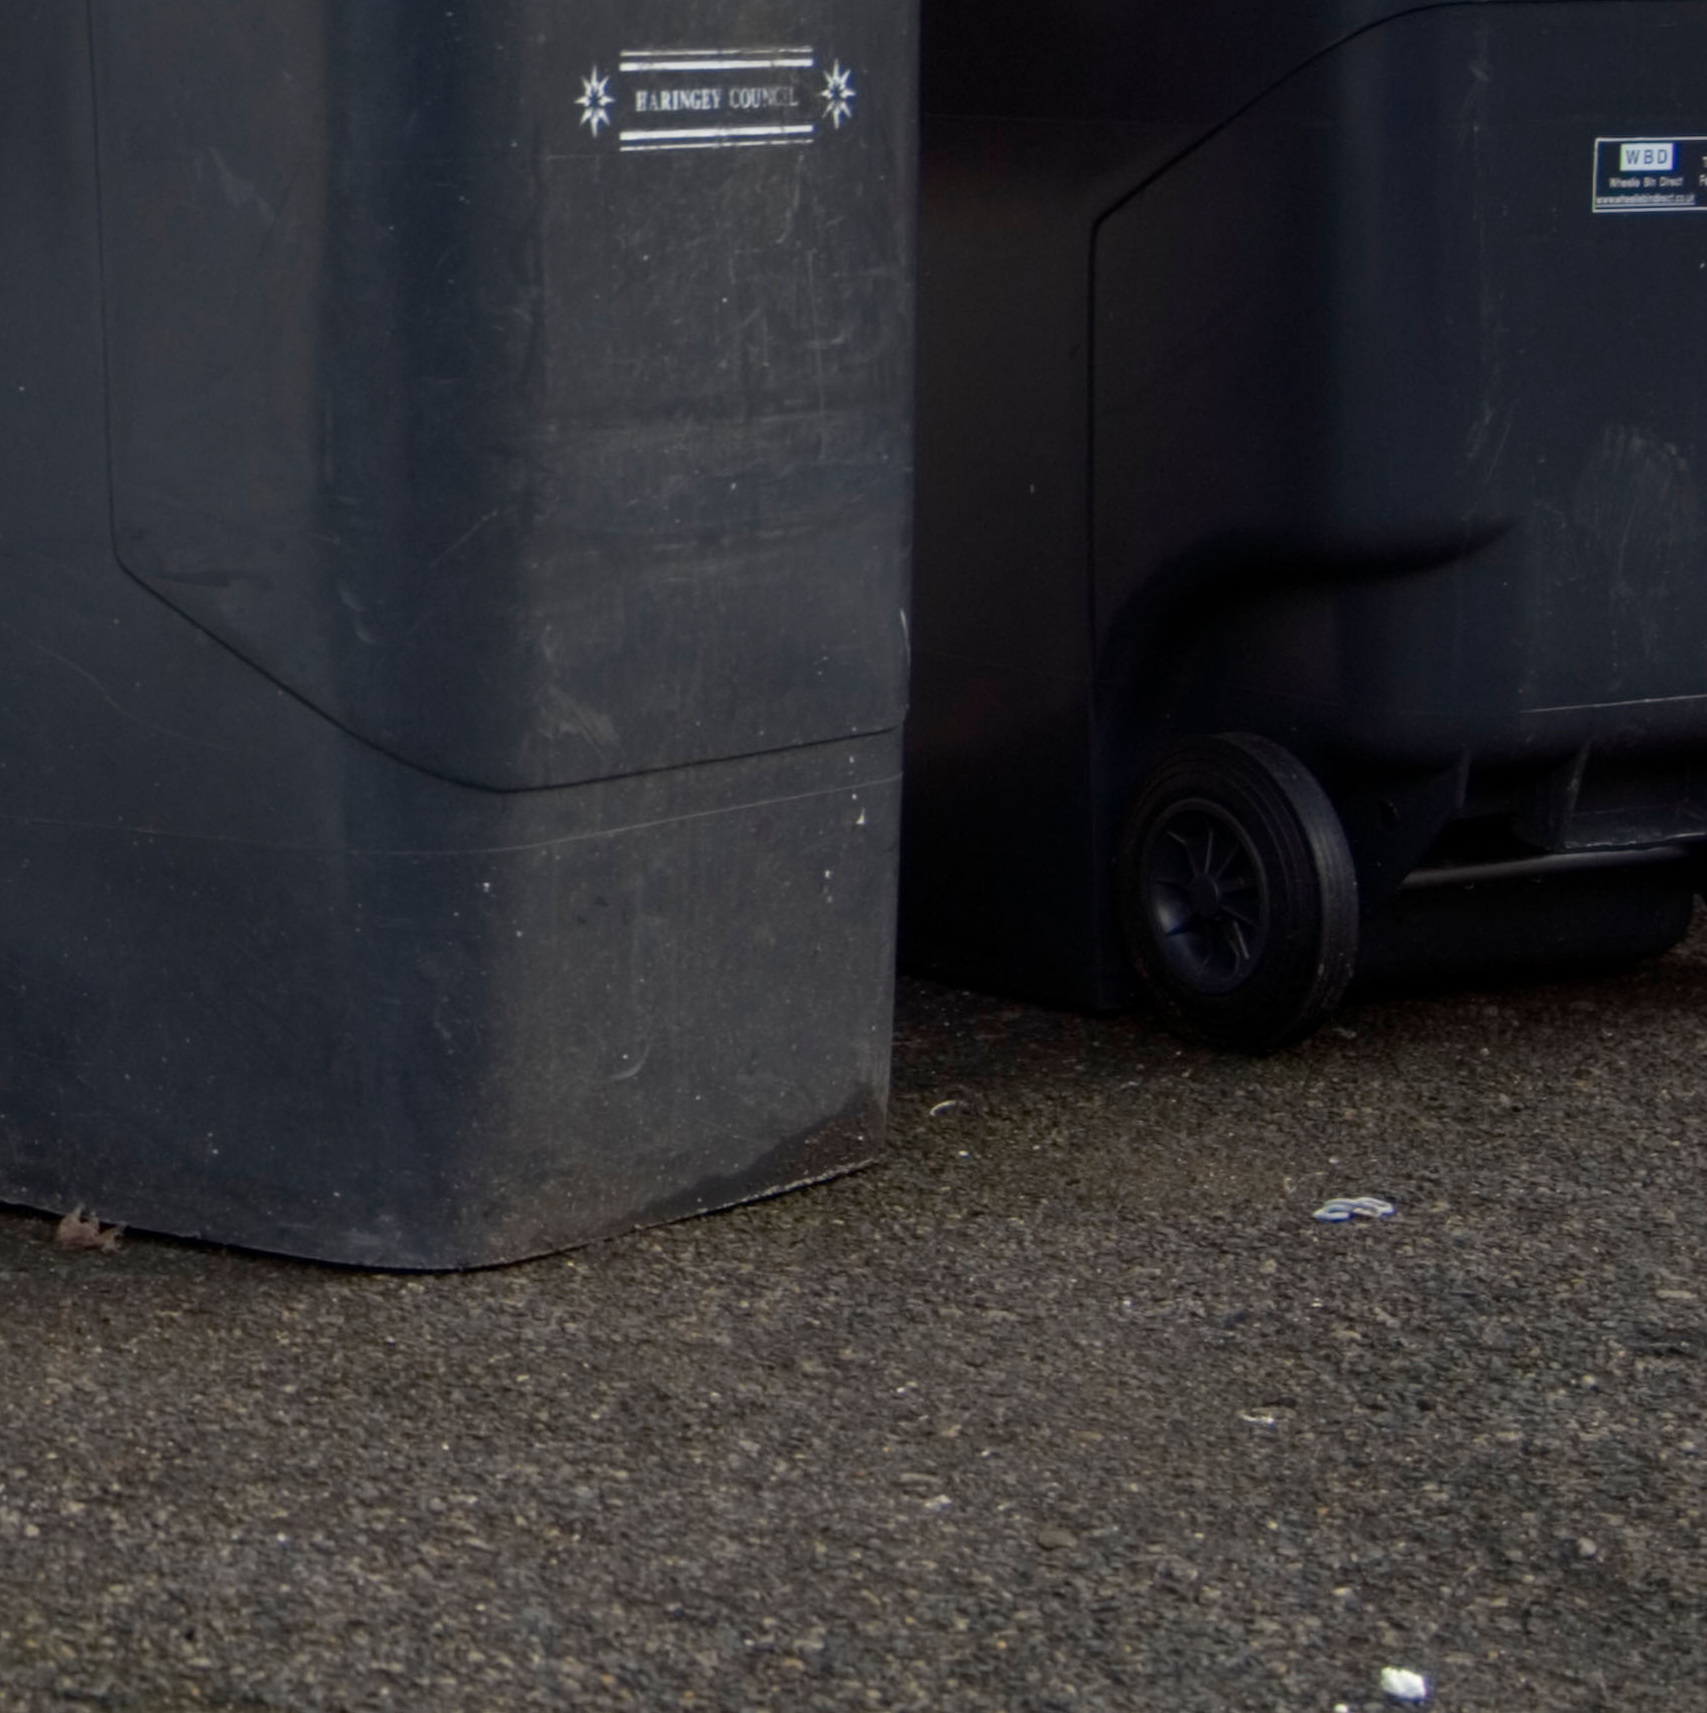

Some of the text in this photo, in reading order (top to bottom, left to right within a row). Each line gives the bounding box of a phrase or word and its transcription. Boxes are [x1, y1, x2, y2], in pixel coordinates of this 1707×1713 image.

[636, 86, 799, 112] HARINGEY COUNCIL
[1627, 149, 1668, 165] WBD
